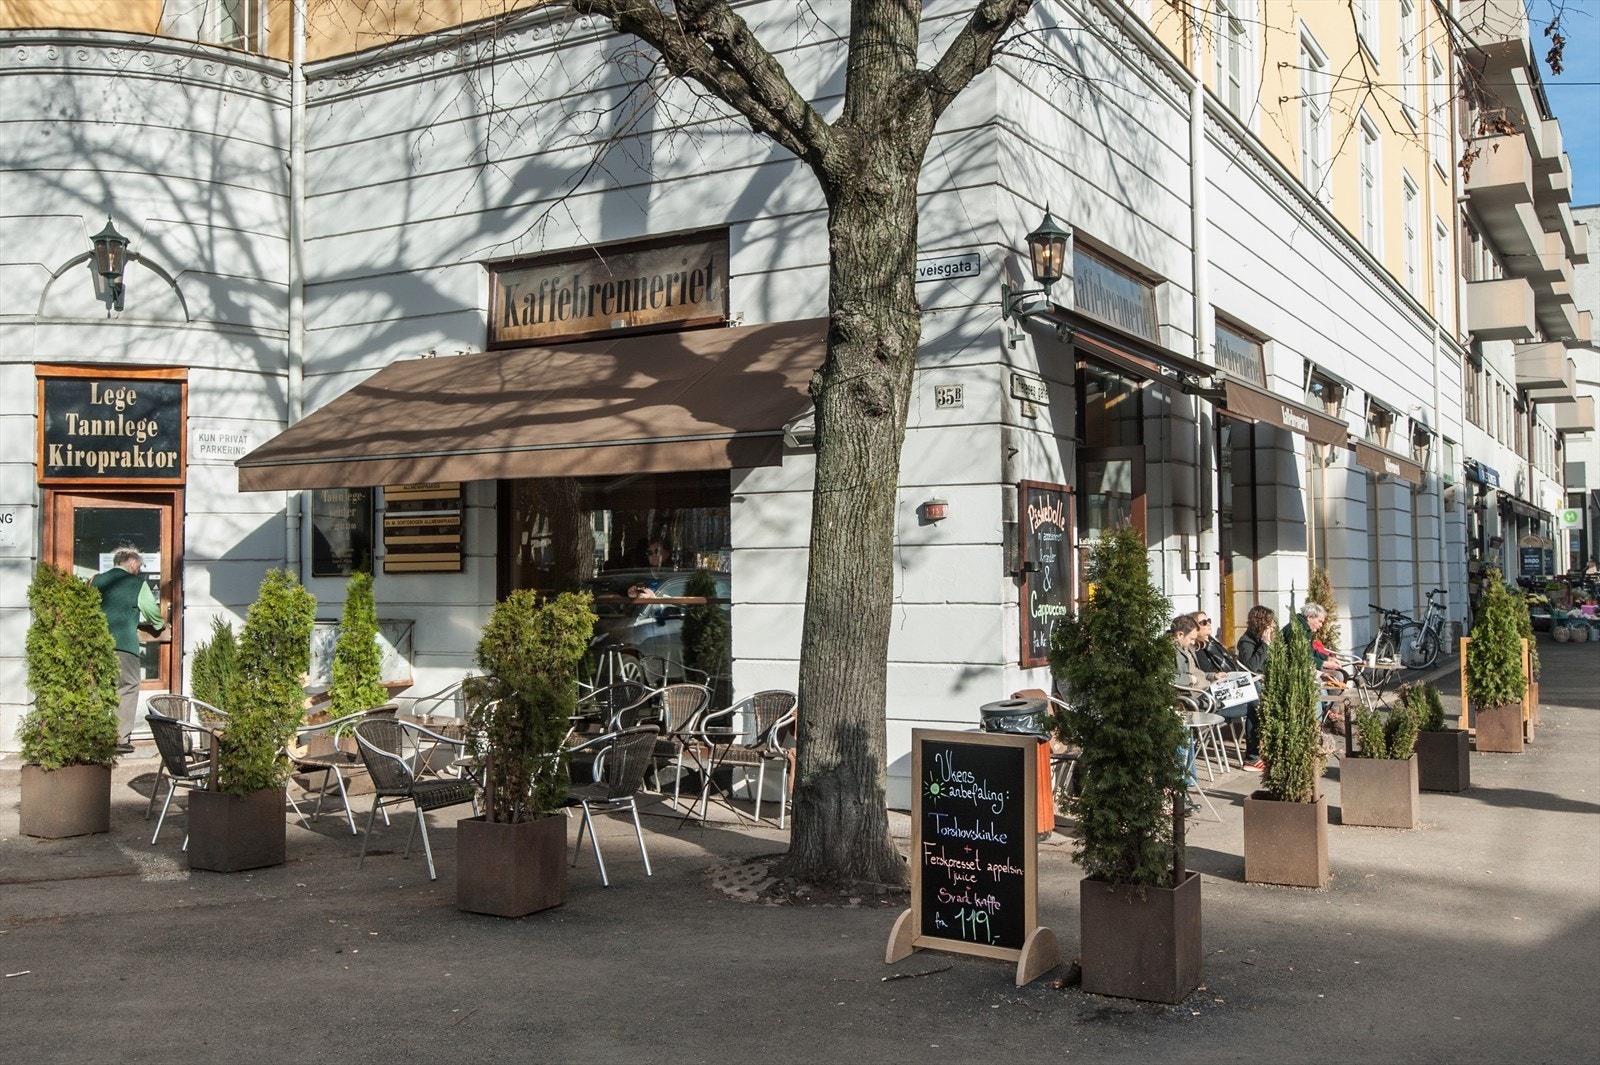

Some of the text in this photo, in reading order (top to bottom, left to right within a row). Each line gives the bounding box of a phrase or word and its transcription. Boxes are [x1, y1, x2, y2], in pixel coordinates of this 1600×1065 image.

[916, 260, 972, 277] veisgata
[503, 254, 718, 328] Kaffebrenneriet
[90, 382, 137, 411] Lege
[937, 387, 961, 406] 35B
[65, 413, 159, 442] Tannlege
[198, 433, 248, 444] KUN PRIVAT
[48, 443, 178, 474] Kiropraktor
[200, 445, 247, 456] PARKERING
[1030, 590, 1067, 625] Cappuccino
[935, 749, 976, 783] Ukens
[949, 779, 1010, 814] anbefaling:
[928, 812, 1008, 844] Torshovskinke
[923, 841, 982, 880] Ferskpresset
[952, 870, 978, 886] juice
[974, 893, 1001, 915] kaffe
